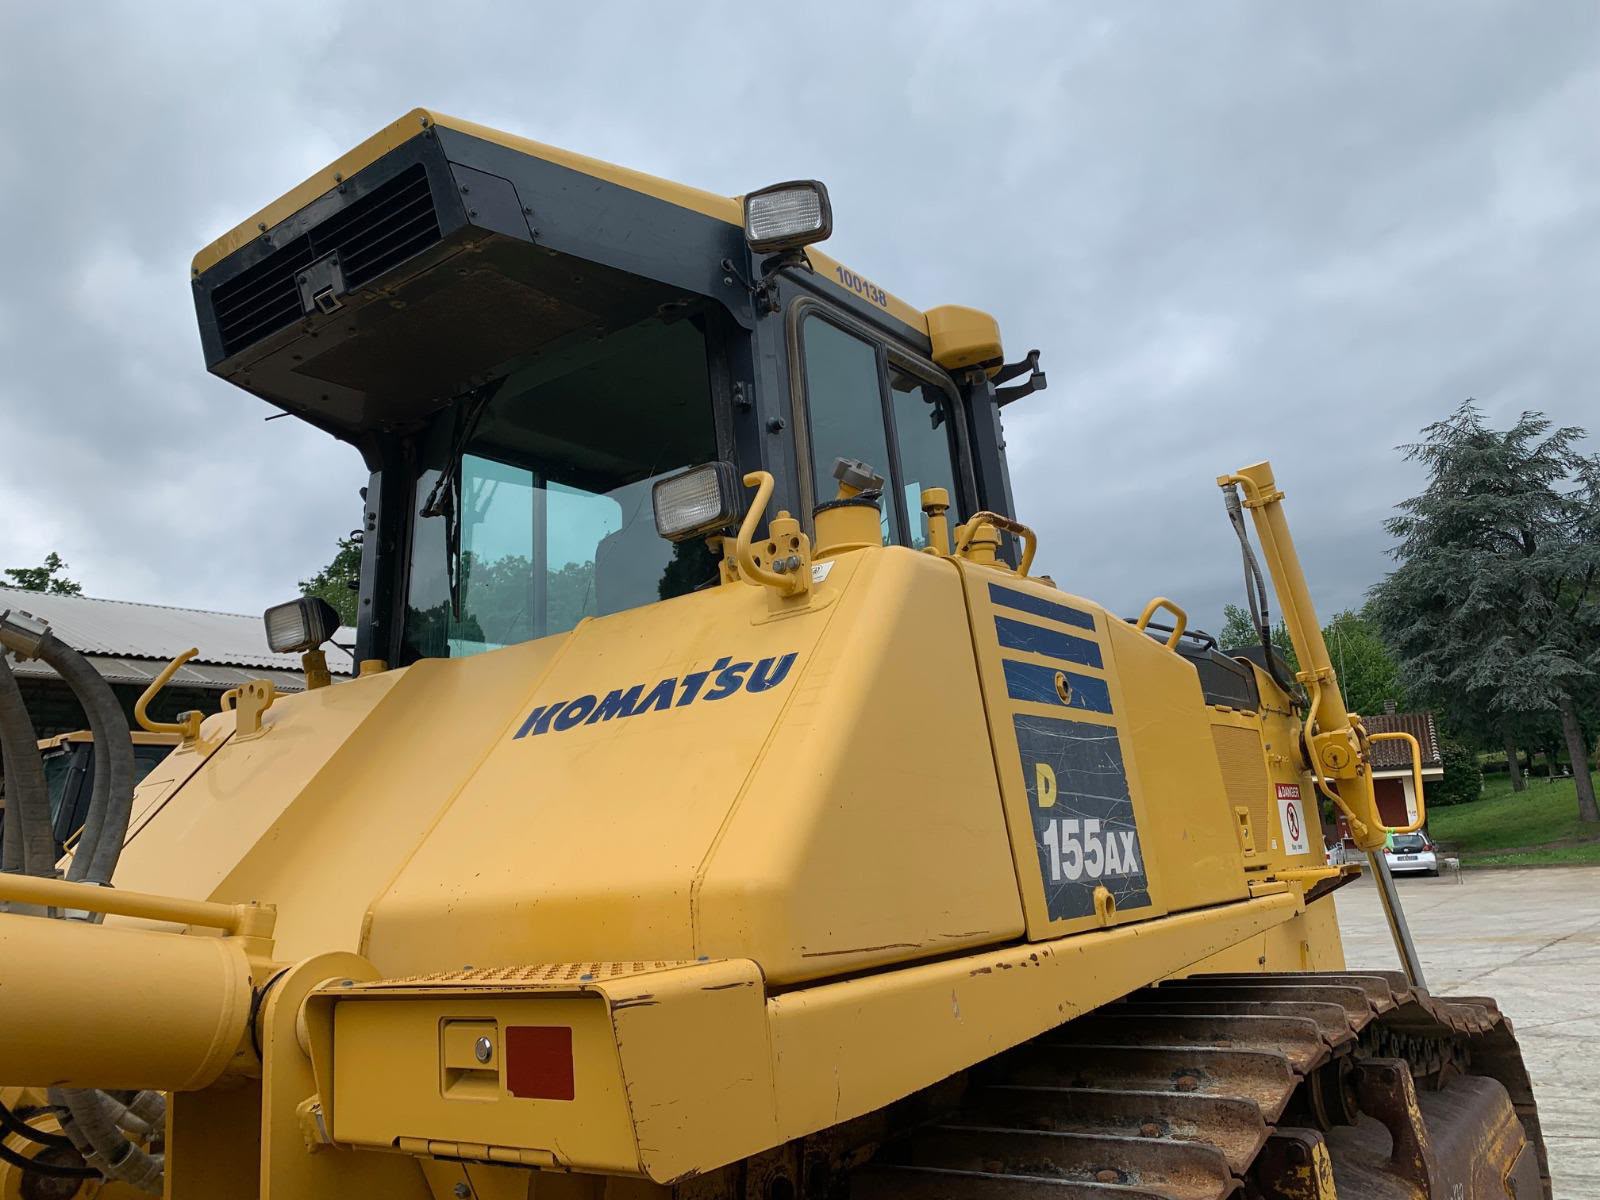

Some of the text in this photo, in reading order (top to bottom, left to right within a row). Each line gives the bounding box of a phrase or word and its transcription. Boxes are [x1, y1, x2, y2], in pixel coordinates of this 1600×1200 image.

[835, 265, 888, 308] 100138
[511, 651, 799, 741] KOMATSU
[1035, 763, 1057, 808] D
[1043, 818, 1140, 881] 155AX
